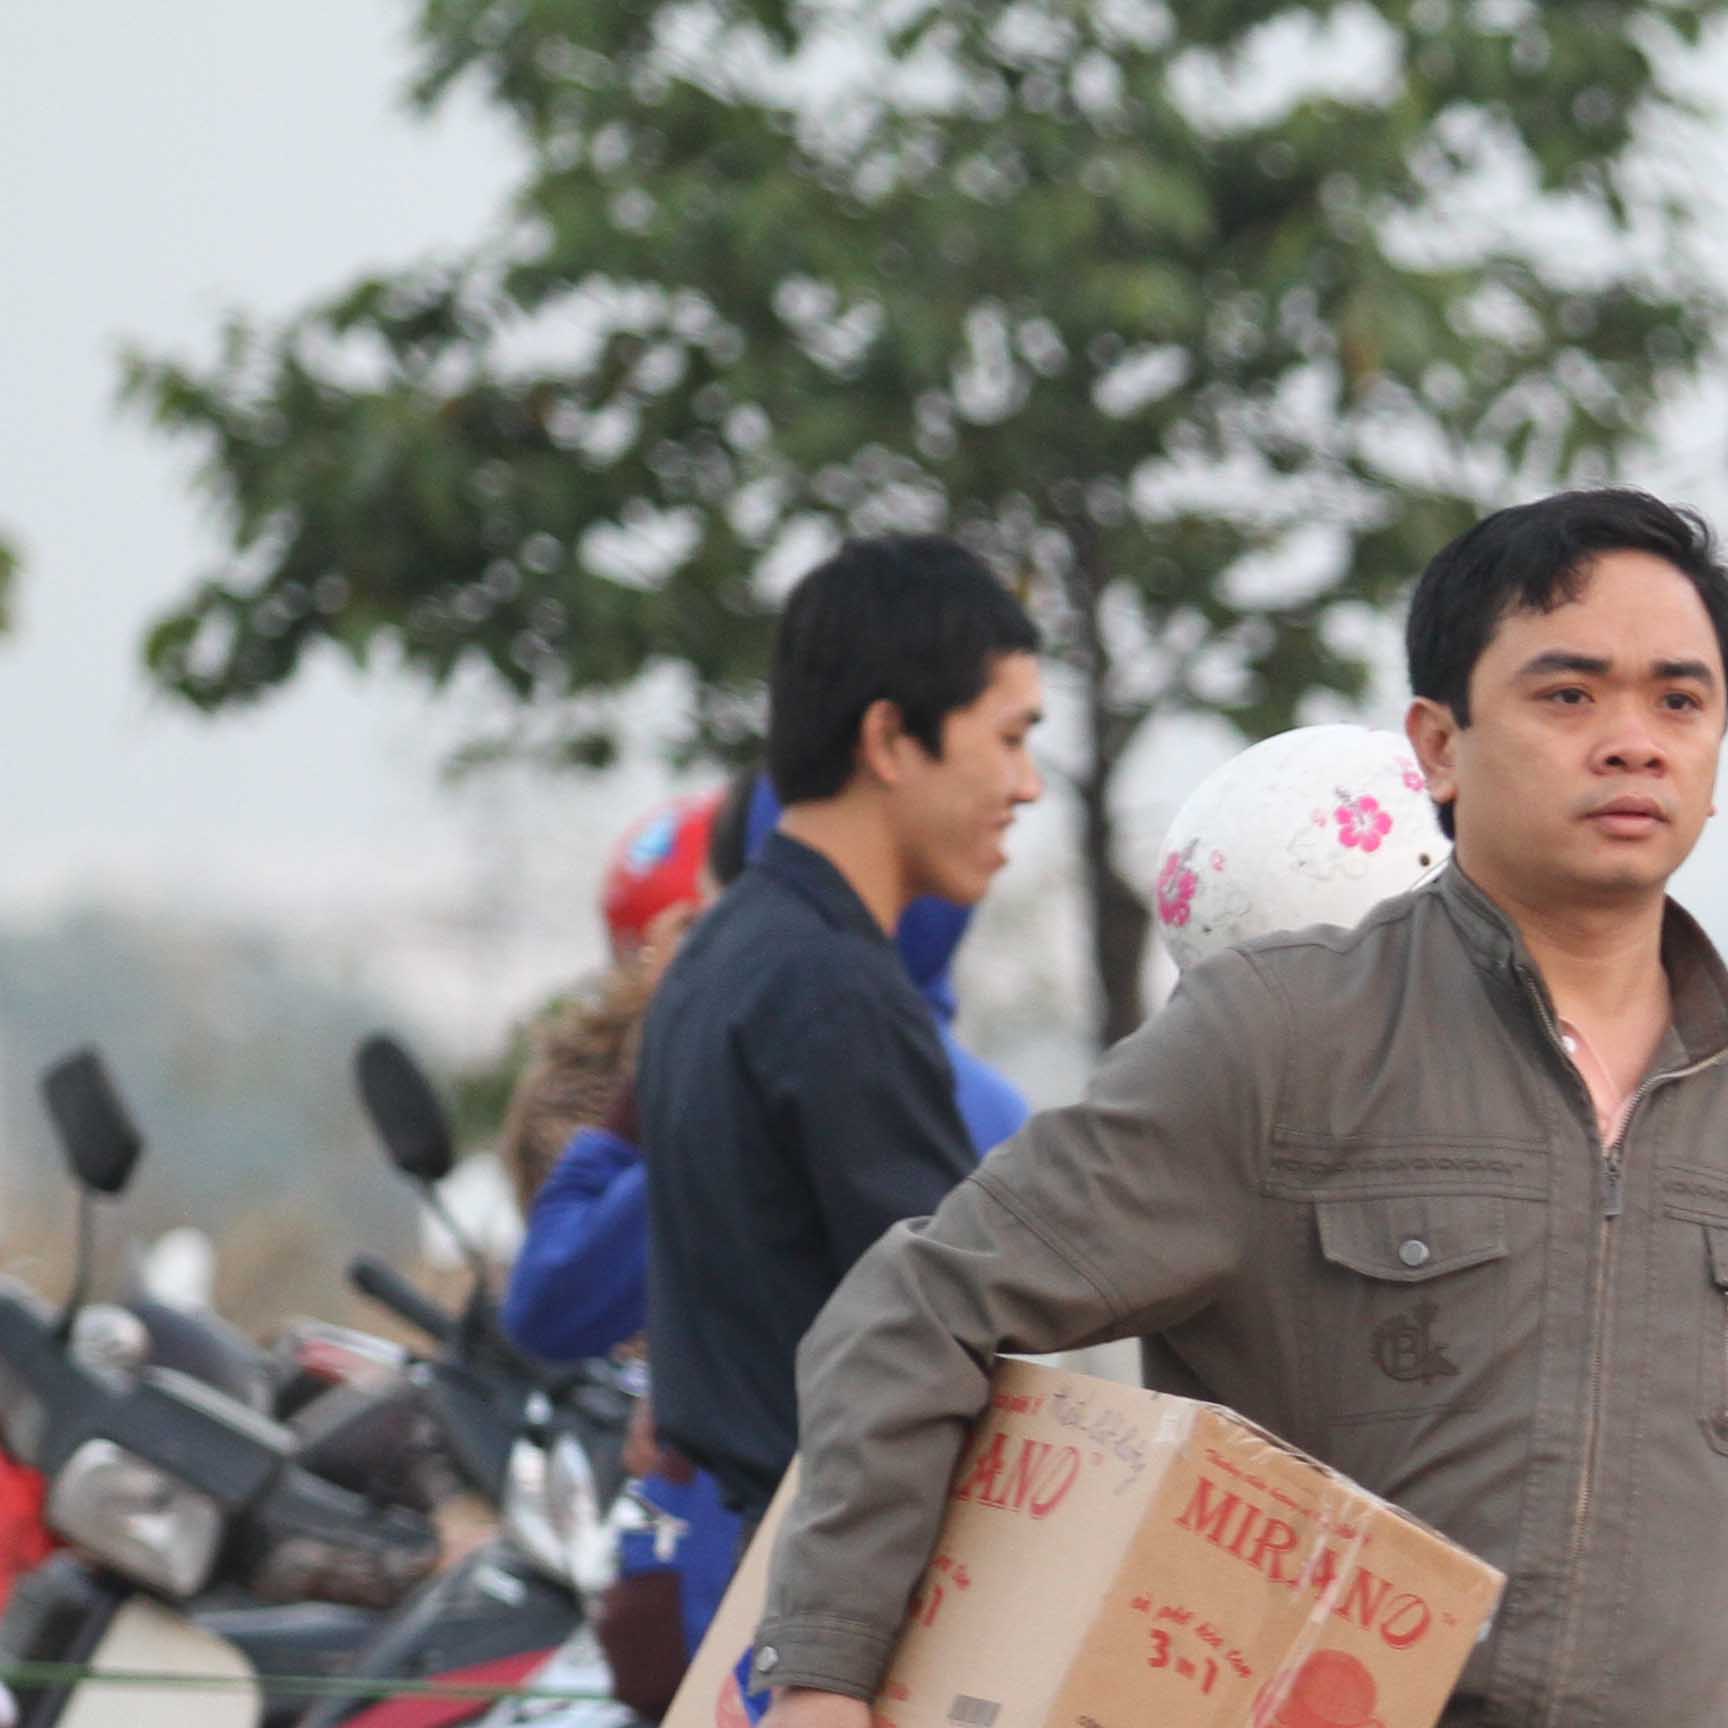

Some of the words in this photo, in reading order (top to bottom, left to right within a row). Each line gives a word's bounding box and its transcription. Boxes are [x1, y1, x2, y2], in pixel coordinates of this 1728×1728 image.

[958, 1432, 1081, 1520] ANO
[1172, 1475, 1432, 1650] MIRANO
[1148, 1628, 1172, 1669] 3
